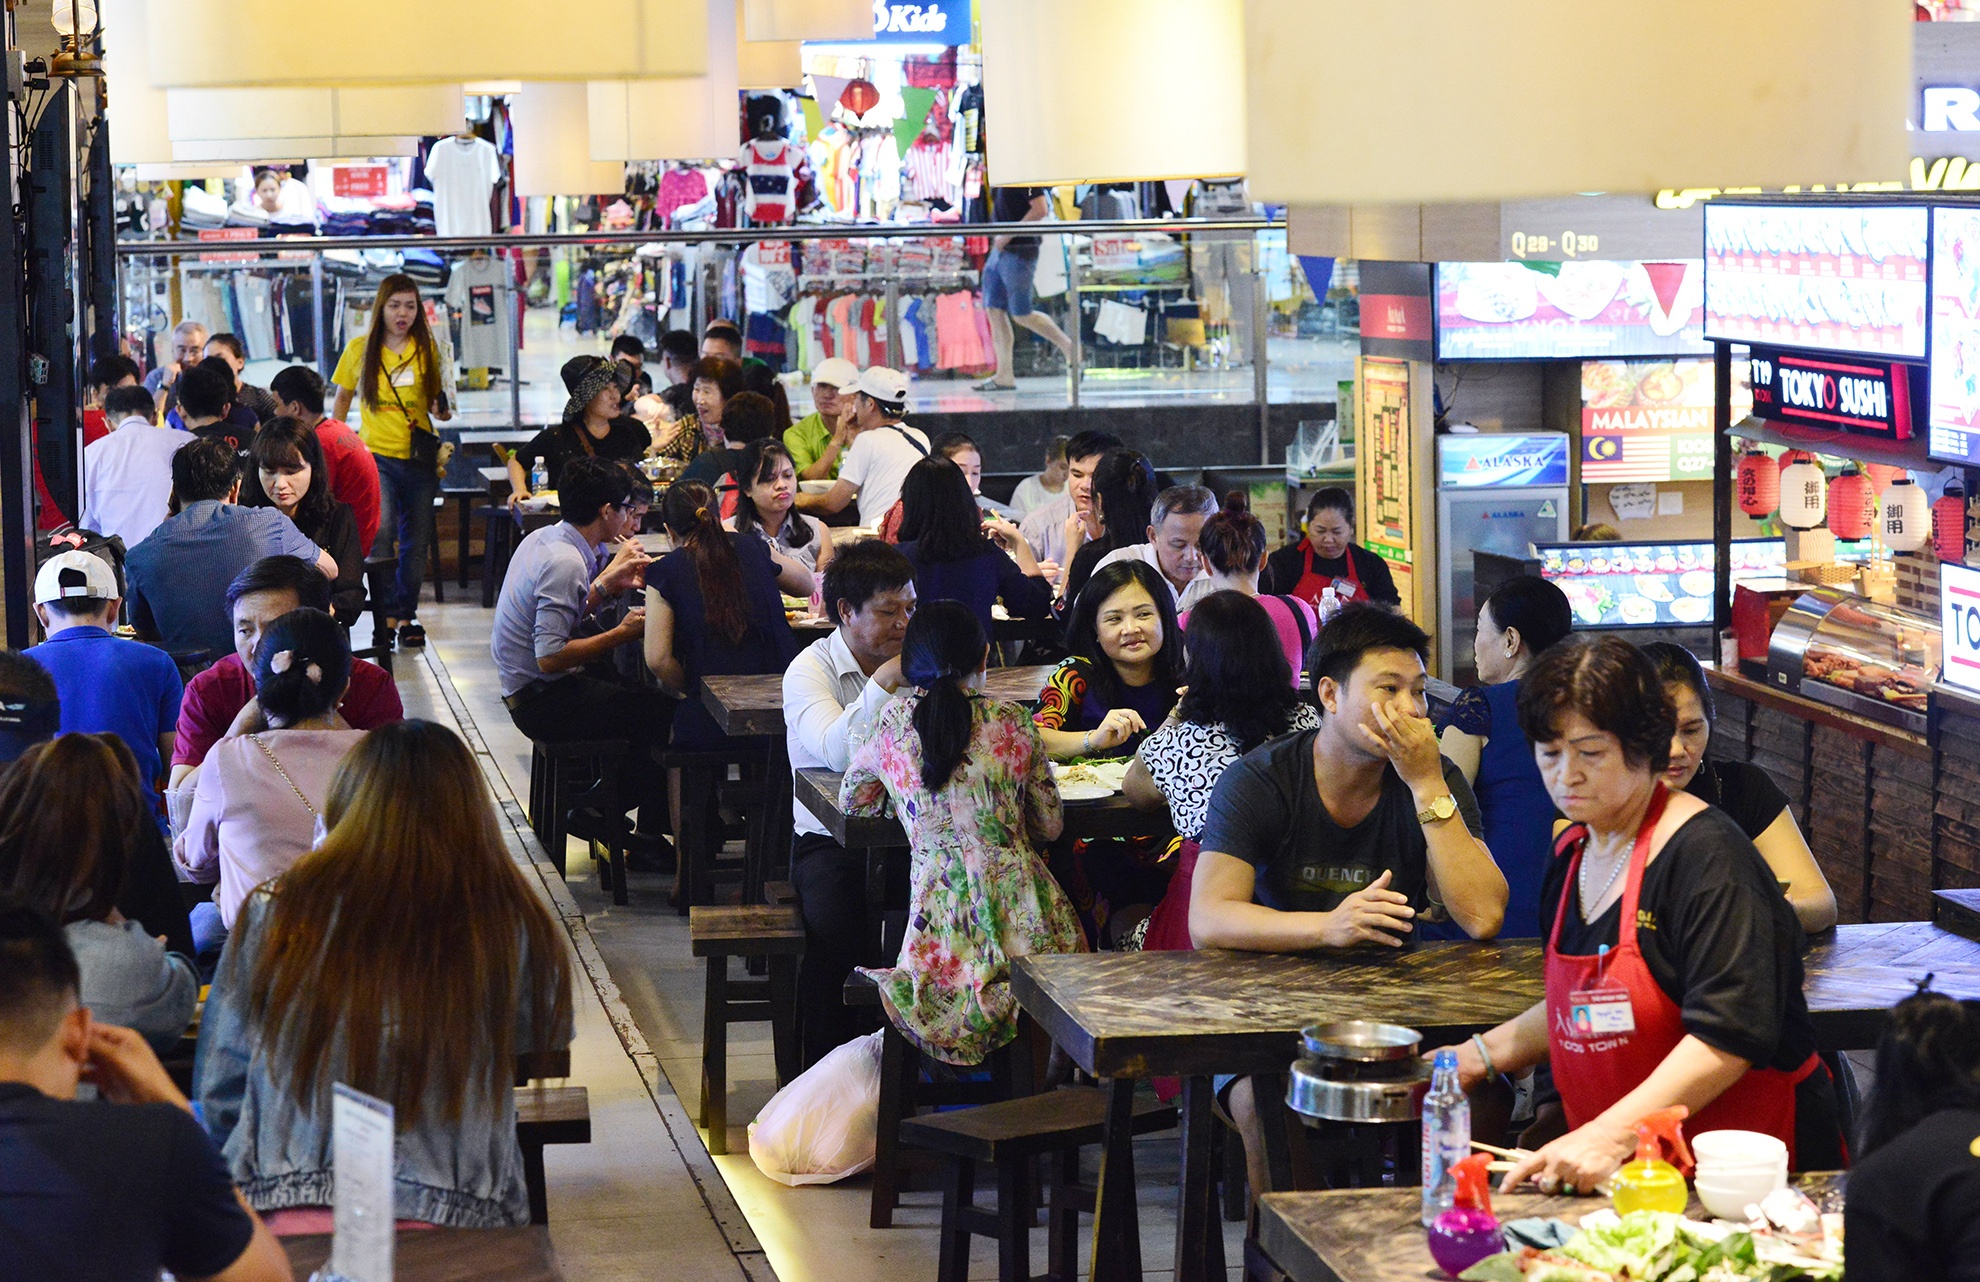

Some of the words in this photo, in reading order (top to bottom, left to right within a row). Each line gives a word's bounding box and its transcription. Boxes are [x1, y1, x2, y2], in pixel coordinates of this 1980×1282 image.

[887, 4, 947, 32] Kids
[1906, 87, 1980, 132] R
[1779, 368, 1836, 410] TOKYO
[1839, 376, 1887, 418] SUSHI
[1591, 408, 1708, 430] MALAYSIAN
[1677, 438, 1714, 454] KIOS
[1482, 456, 1545, 468] ALASKA
[1677, 456, 1714, 473] Q27-
[1887, 503, 1904, 535] 御用
[1951, 602, 1980, 651] TO
